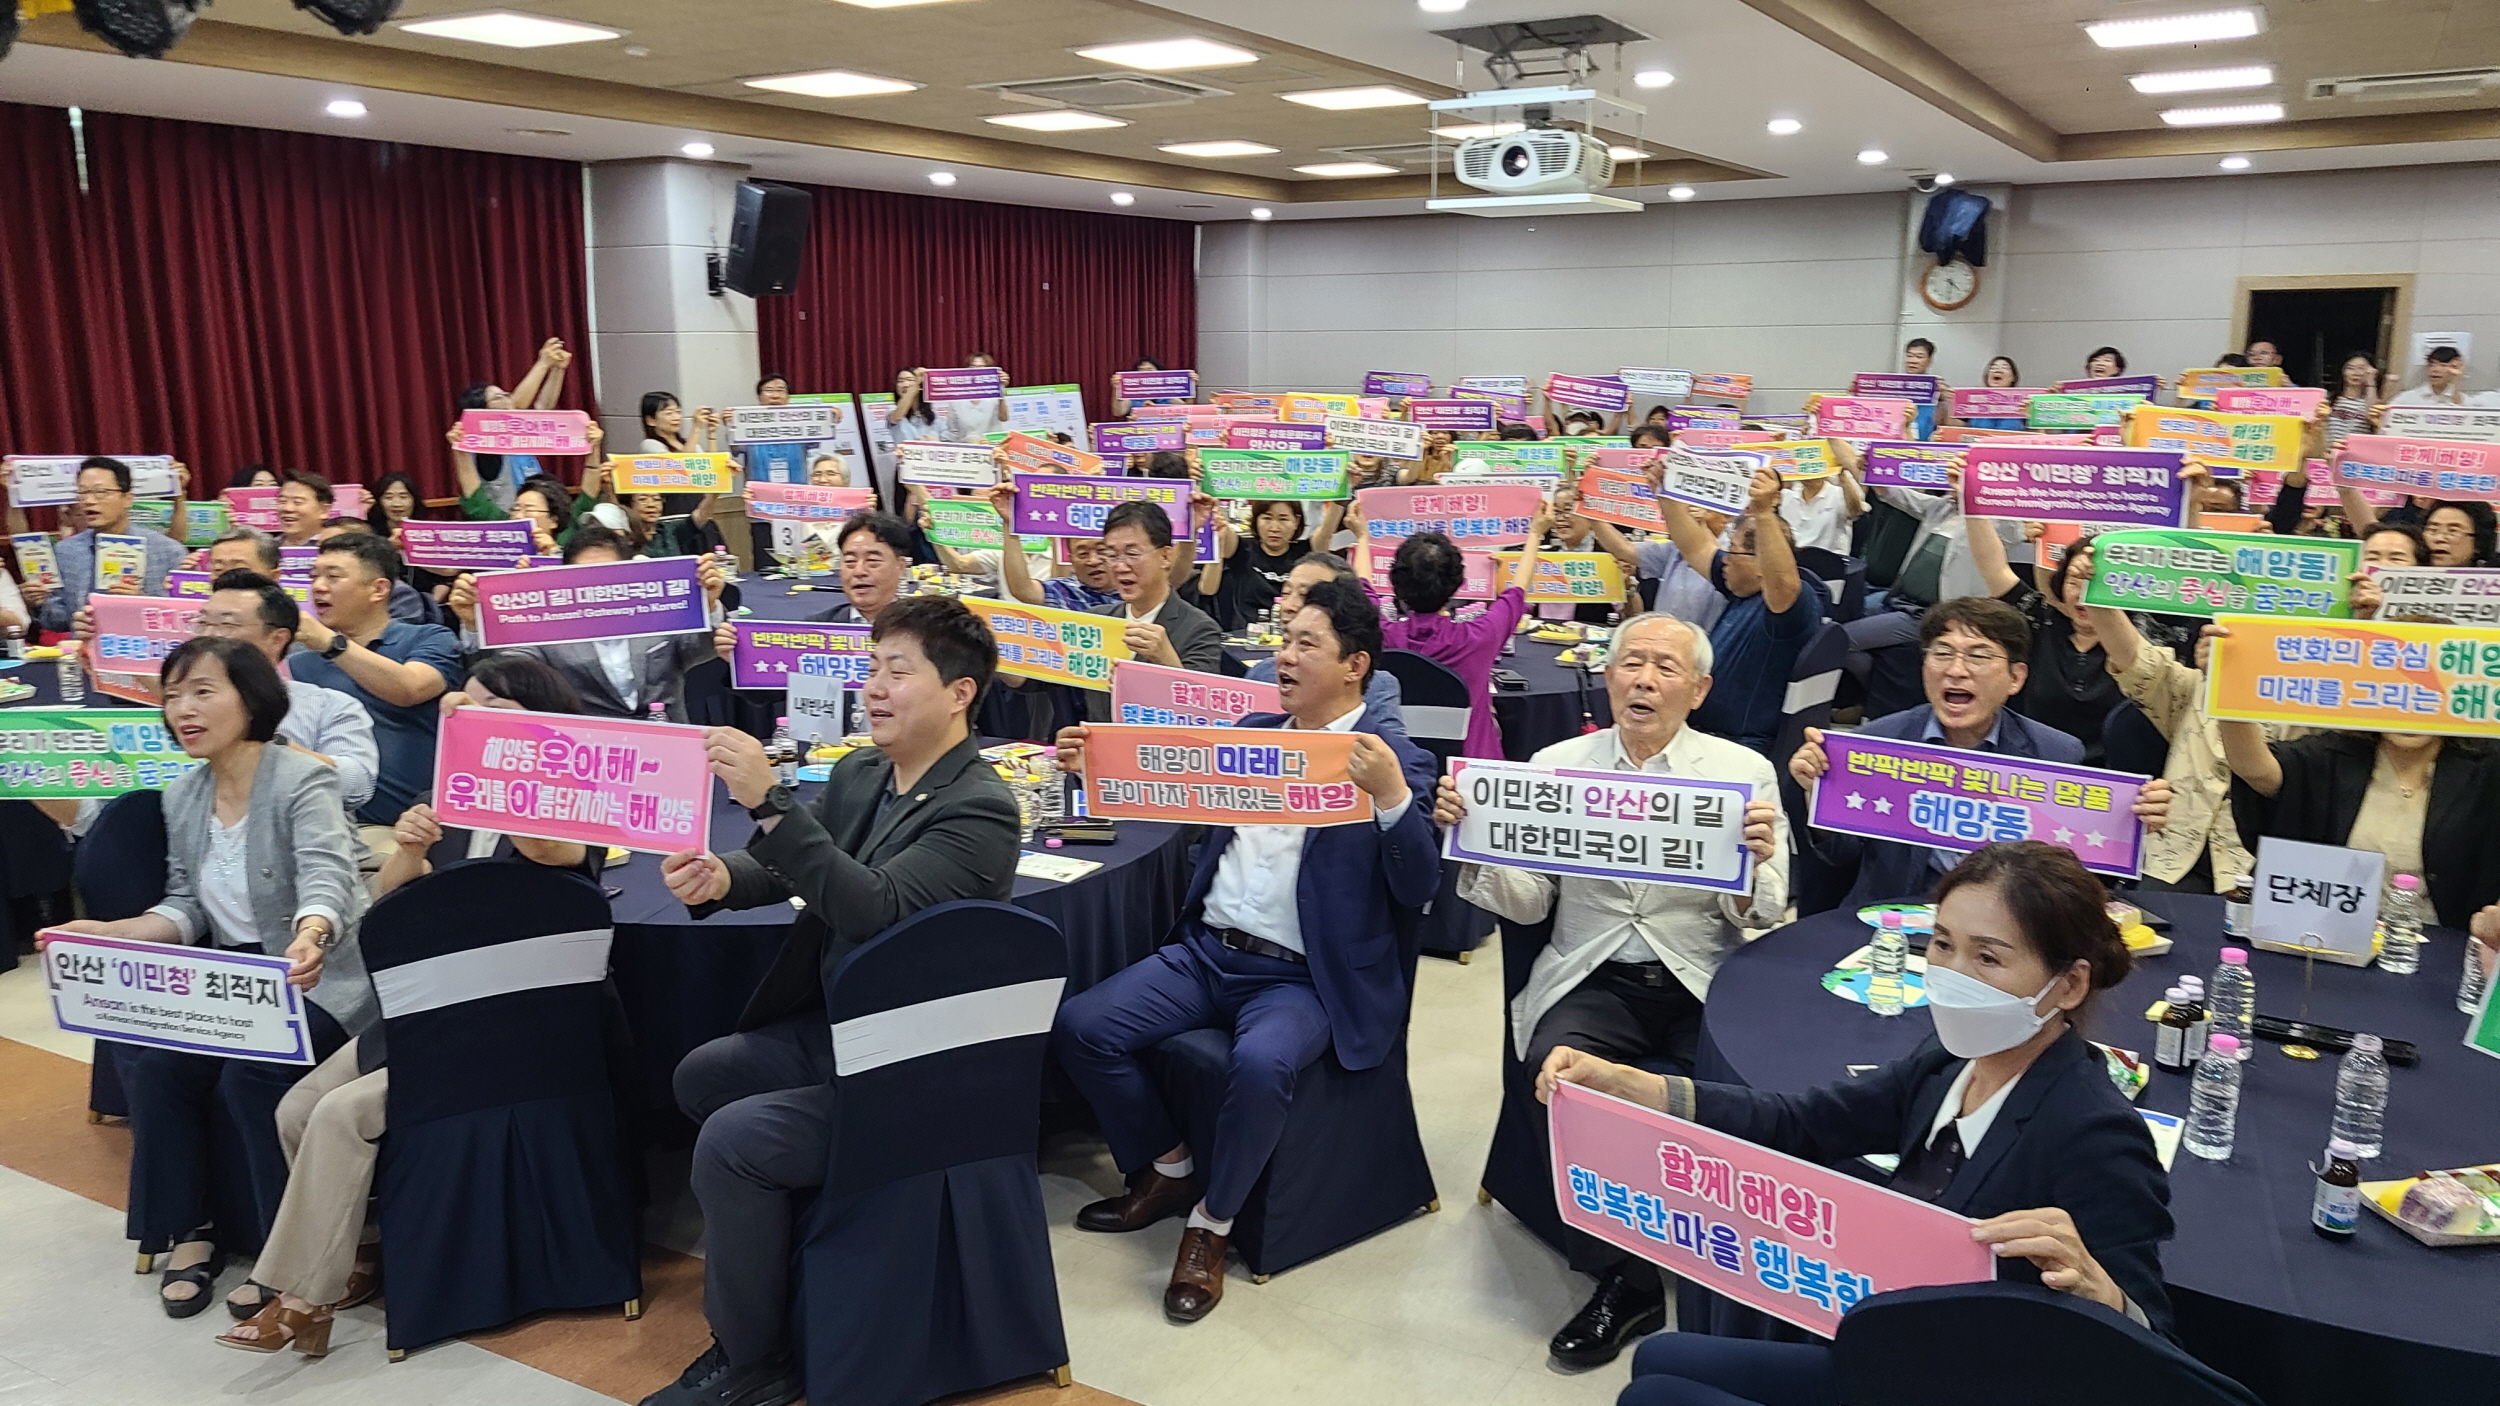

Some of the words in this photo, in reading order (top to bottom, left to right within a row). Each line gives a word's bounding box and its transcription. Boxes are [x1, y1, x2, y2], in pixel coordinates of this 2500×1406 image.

[1209, 458, 1247, 474] 우리가
[1247, 459, 1284, 473] 만드는
[1284, 456, 1341, 475] 해양동!
[1977, 461, 2020, 482] 안산
[2103, 465, 2169, 489] 최적지
[2339, 461, 2396, 483] 행복한
[2437, 472, 2498, 493] 행복한
[1029, 483, 1094, 500] 반짝반짝
[1095, 486, 1144, 502] 빛나는
[1146, 487, 1177, 503] 명품
[1296, 477, 1341, 493] 꿈꾸다
[1411, 494, 1445, 514] 함께
[1447, 493, 1488, 513] 해양!
[1367, 519, 1415, 538] 행복한
[1452, 516, 1502, 537] 행복한
[2104, 542, 2167, 569] 우리가
[2168, 546, 2232, 572] 만드는
[2233, 545, 2339, 583] 해양동!
[489, 589, 546, 611] 안산의
[548, 588, 573, 607] 길!
[576, 580, 664, 604] 대한민국의
[665, 579, 691, 597] 길!
[2178, 576, 2250, 608] 중심을
[2252, 583, 2338, 615] 꿈꾸다
[2380, 575, 2457, 595] 이민청!
[499, 613, 527, 624] Path
[528, 613, 541, 623] to
[542, 610, 582, 622] Ansan!
[584, 606, 635, 619] Gateway
[636, 605, 650, 614] to
[651, 600, 688, 611] Korea!
[752, 631, 827, 649] 반짝반짝
[989, 613, 1029, 636] 변화의
[1031, 619, 1057, 642] 중심
[1060, 621, 1103, 650] 해양!
[1025, 646, 1064, 671] 그리는
[1065, 653, 1109, 680] 해양!
[2275, 634, 2360, 666] 변화의
[2370, 638, 2430, 671] 중심
[793, 696, 836, 720] 내빈석
[1171, 680, 1208, 710] 함께
[1208, 688, 1254, 716] 해양!
[2257, 675, 2343, 707] 미래를
[2350, 680, 2442, 714] 그리는
[50, 729, 110, 753] 만드는
[69, 759, 134, 788] 중심을
[482, 736, 537, 773] 해양동
[536, 739, 663, 787] 우아해~
[1137, 744, 1213, 776] 해양이
[1213, 744, 1307, 780] 미래다
[1097, 778, 1189, 808] 같이가자
[1189, 781, 1285, 813] 가치있는
[1285, 780, 1358, 812] 해양
[1847, 749, 1957, 789] 반짝반짝
[1962, 766, 2047, 803] 빛나는
[2053, 779, 2114, 813] 명품
[445, 772, 507, 813] 우리를
[508, 778, 625, 828] 아름답게하는
[627, 790, 696, 835] 해양동
[1473, 776, 1574, 815] 이민청!
[1583, 785, 1681, 825] 안산의
[1692, 794, 1726, 829] 길
[1909, 789, 2034, 843] 해양동
[1489, 821, 1648, 867] 대한민국의
[1660, 836, 1705, 871] 길!
[2267, 872, 2367, 915] 단체장
[56, 952, 106, 985] 안산
[205, 971, 281, 1008] 최적지
[82, 993, 127, 1012] Ansan
[129, 1001, 139, 1013] is
[141, 1003, 156, 1016] the
[158, 1006, 182, 1020] best
[185, 1010, 215, 1025] place
[217, 1014, 228, 1025] to
[229, 1015, 254, 1028] host
[1656, 1140, 1735, 1211] 함께
[1737, 1171, 1837, 1249] 해양!
[1567, 1163, 1670, 1244] 행복한
[1670, 1210, 1745, 1275] 마을
[1751, 1235, 1878, 1315] 행복한
